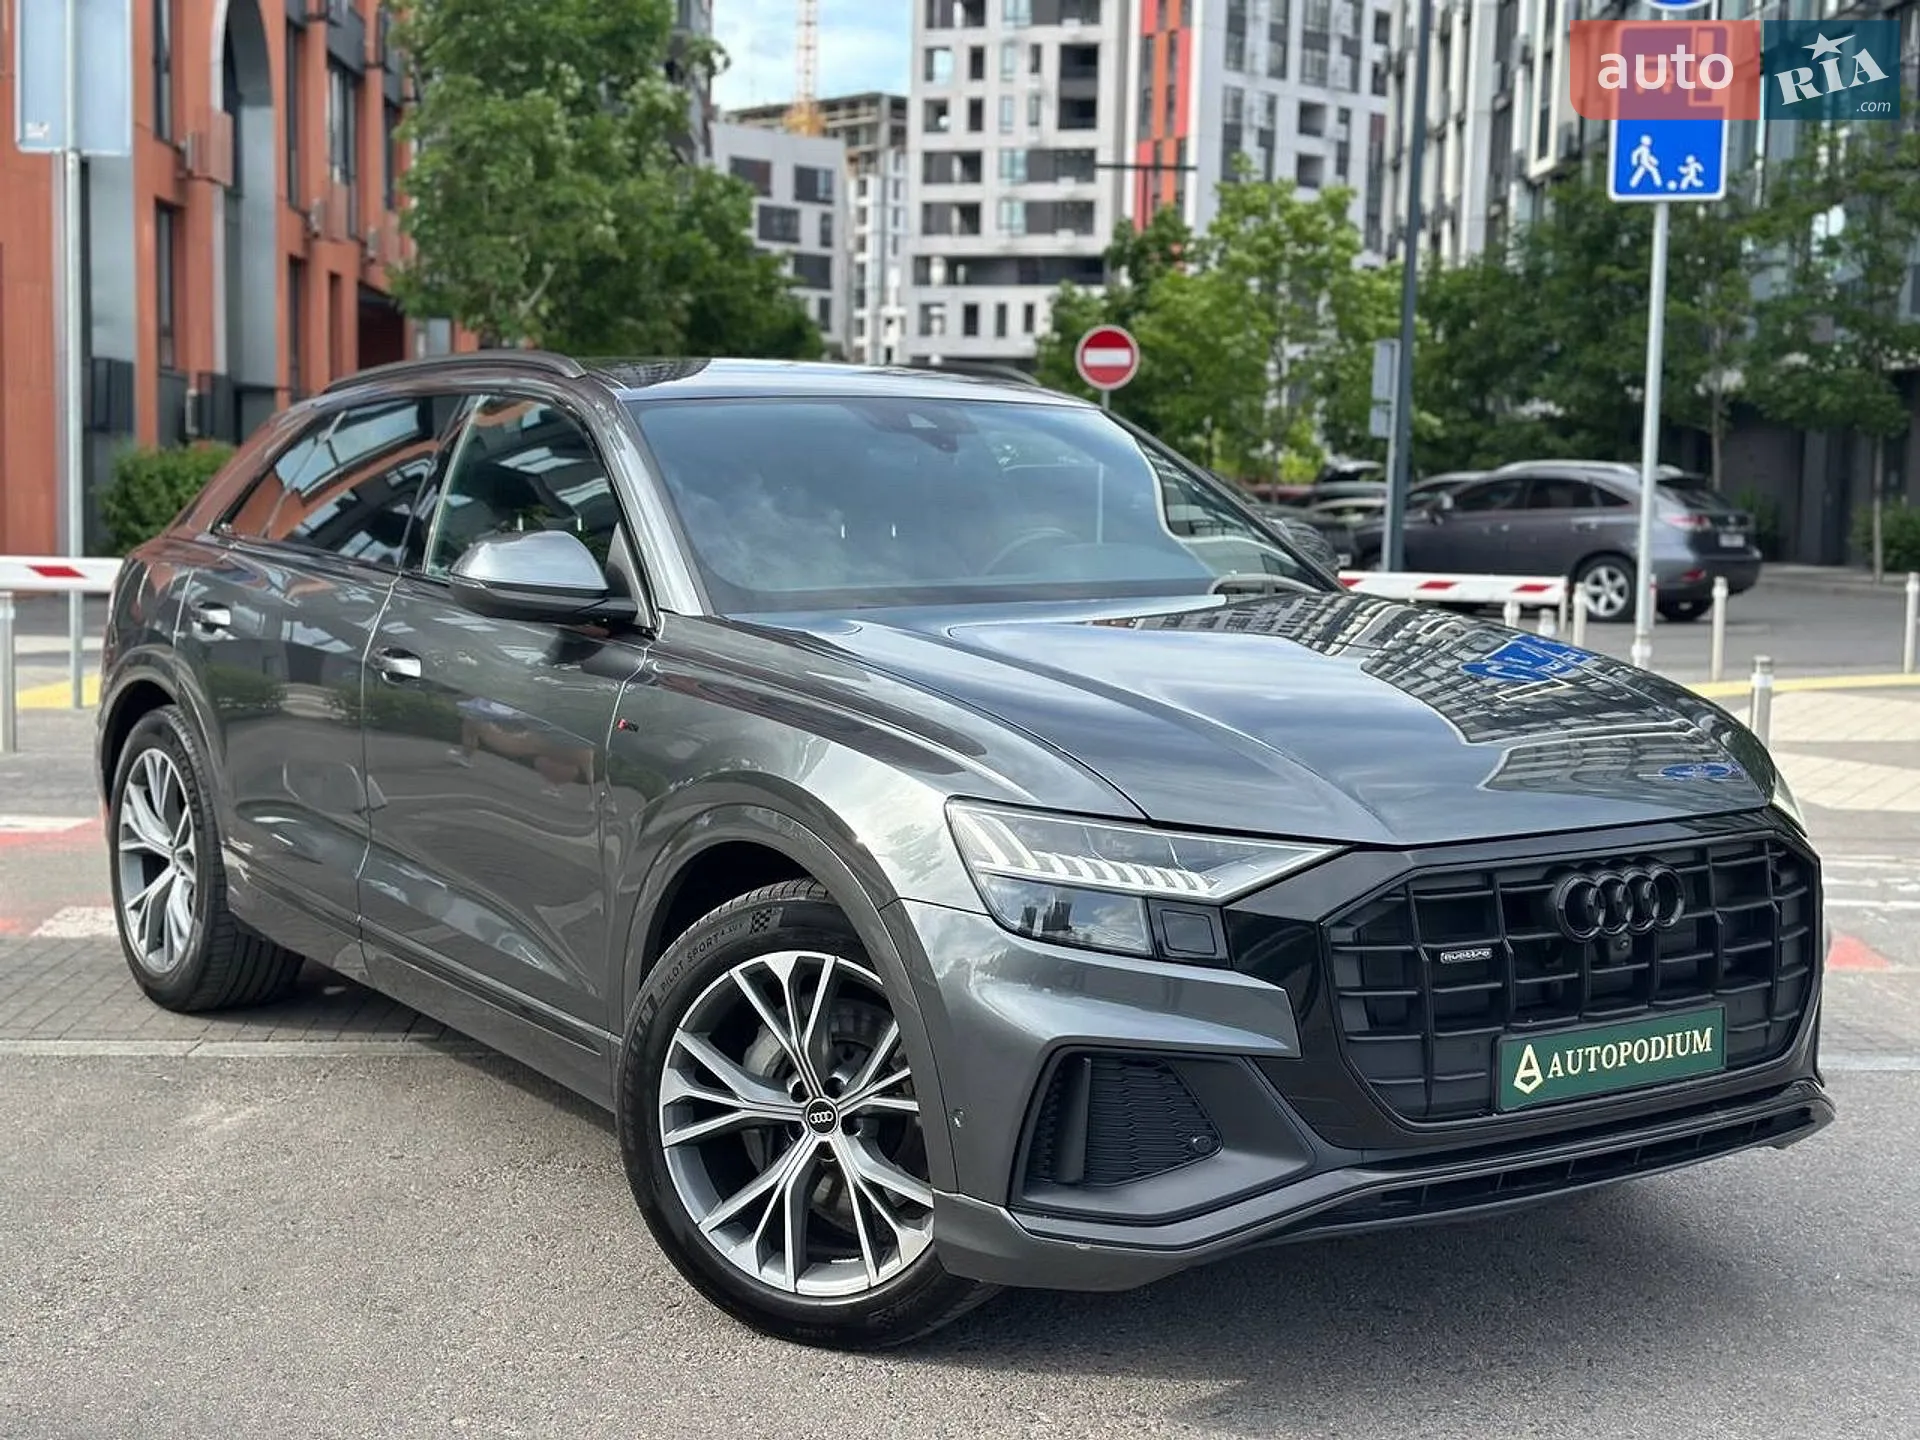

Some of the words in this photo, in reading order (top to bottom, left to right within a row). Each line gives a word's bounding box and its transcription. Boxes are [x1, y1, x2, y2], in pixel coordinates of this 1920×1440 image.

[660, 961, 685, 991] PILOT
[687, 932, 719, 961] SPORT
[1547, 1027, 1713, 1078] AUTOPODIUM
